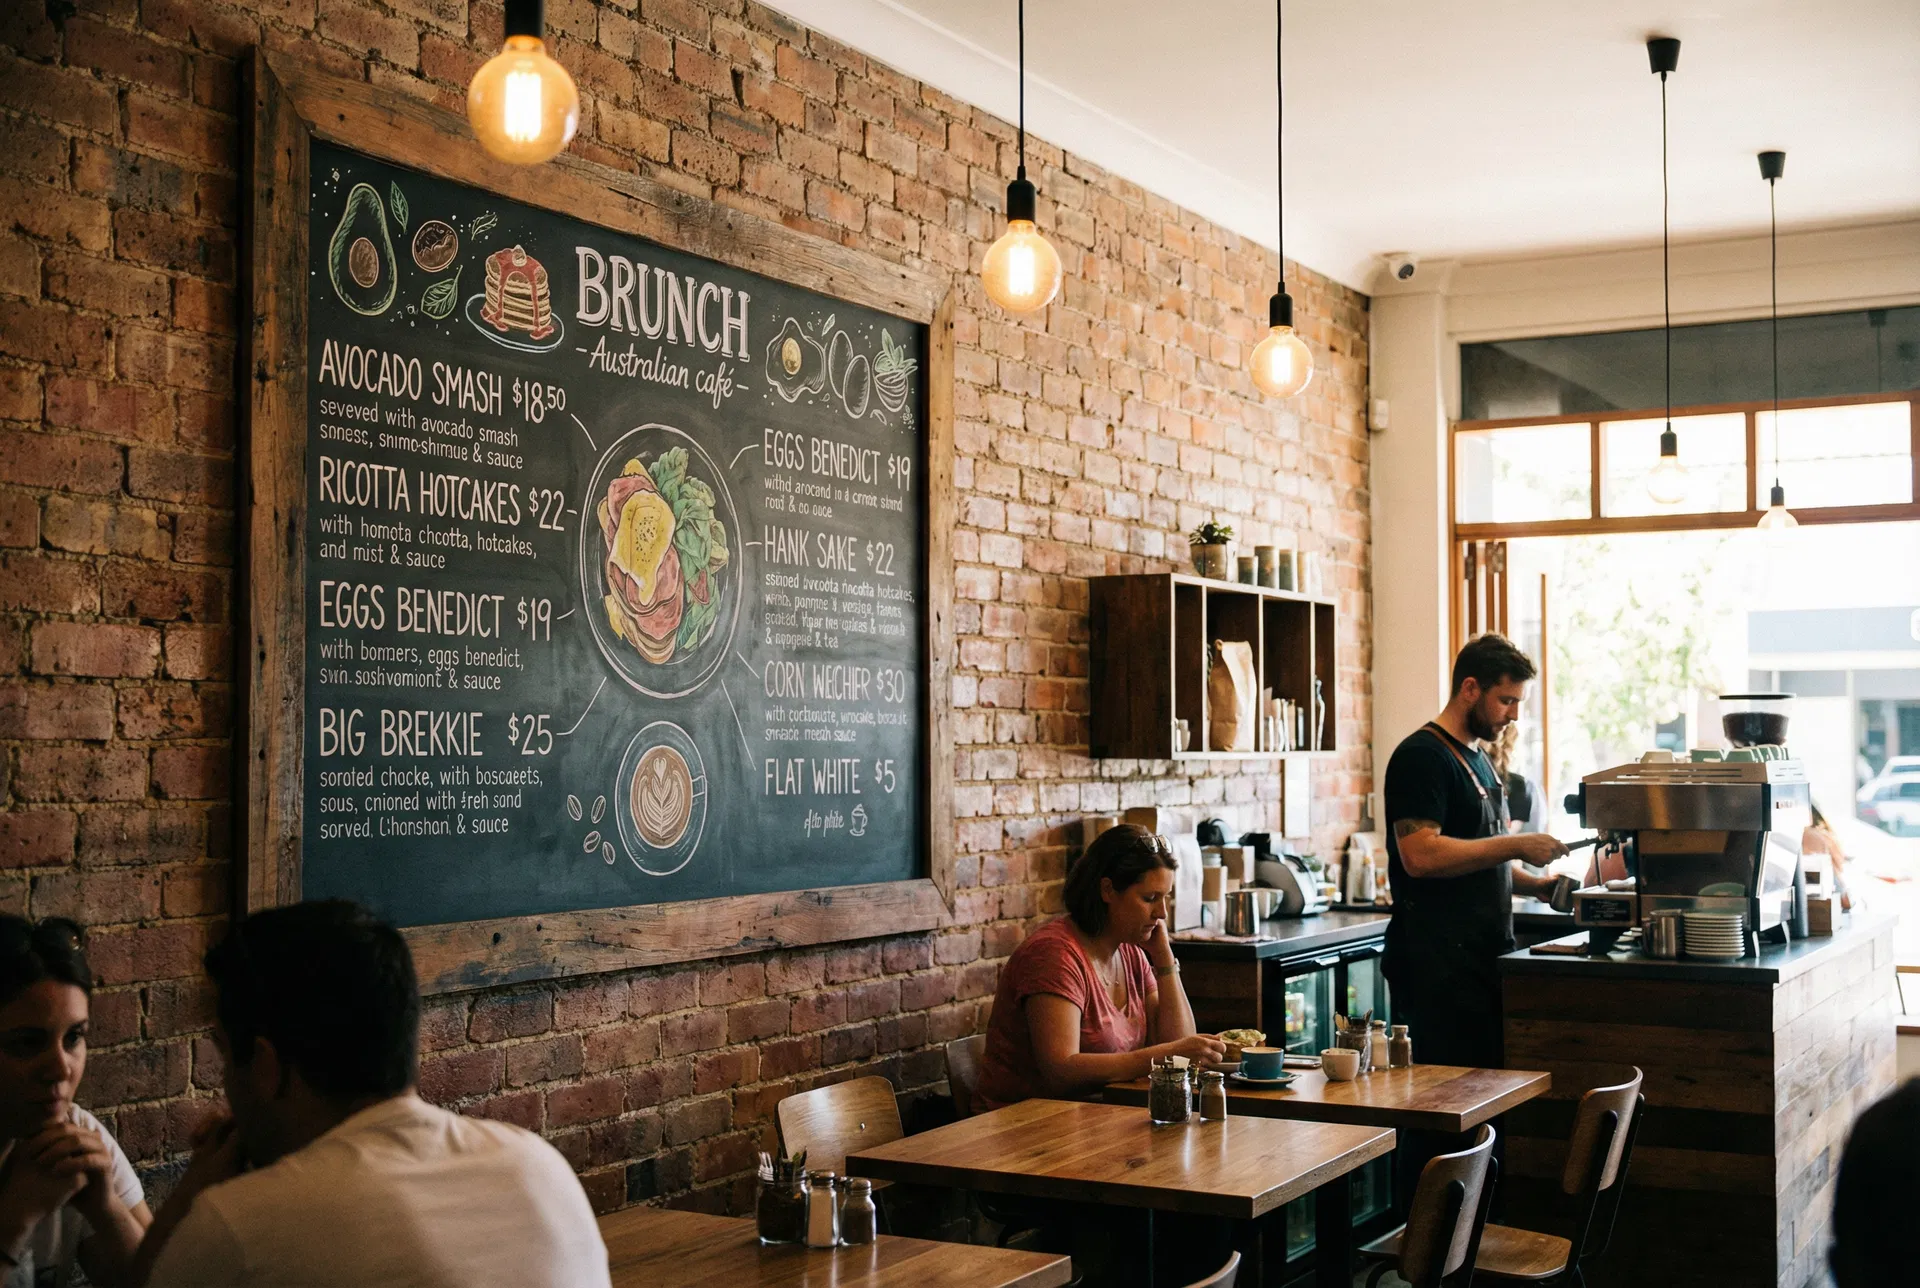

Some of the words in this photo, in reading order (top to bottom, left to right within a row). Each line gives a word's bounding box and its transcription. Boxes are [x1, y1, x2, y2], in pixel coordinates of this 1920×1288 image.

[575, 246, 750, 362] BRUNCH
[319, 339, 422, 401] AVOCADO
[432, 361, 502, 416] SMASH
[512, 377, 566, 424] $18.50
[589, 335, 689, 389] Australian
[695, 361, 734, 409] café
[385, 407, 416, 430] with
[421, 418, 473, 439] avocado
[479, 427, 518, 447] smash
[472, 442, 482, 463] &
[487, 451, 523, 469] sauce
[764, 428, 805, 471] EGGS
[811, 437, 881, 485] BENEDICT
[888, 453, 911, 491] $19
[319, 455, 411, 513] RICOTTA
[420, 471, 520, 526] HOTCAKES
[789, 495, 796, 512] &
[320, 514, 353, 535] with
[477, 528, 537, 559] hotcakes,
[320, 539, 346, 559] and
[390, 543, 402, 565] &
[406, 551, 446, 569] sauce
[765, 525, 810, 567] HANK
[817, 532, 858, 572] SAKE
[866, 540, 895, 576] $22
[320, 580, 385, 630] EGGS
[397, 586, 505, 638] BENEDICT
[517, 596, 551, 641] $19
[320, 638, 353, 660] with
[427, 649, 460, 671] eggs
[465, 645, 524, 671] benedict,
[448, 668, 458, 689] &
[463, 674, 501, 690] sauce
[765, 660, 805, 698] CORN
[877, 666, 905, 703] $30
[320, 708, 366, 756] BIG
[381, 709, 483, 756] BREKKIE
[508, 712, 553, 756] $25
[765, 705, 785, 721] with
[440, 764, 470, 785] with
[765, 758, 805, 795] FLAT
[812, 758, 861, 794] WHITE
[875, 758, 896, 793] $5
[426, 790, 456, 810] with
[493, 788, 522, 809] sand
[457, 813, 466, 834] &
[472, 818, 509, 834] sauce
